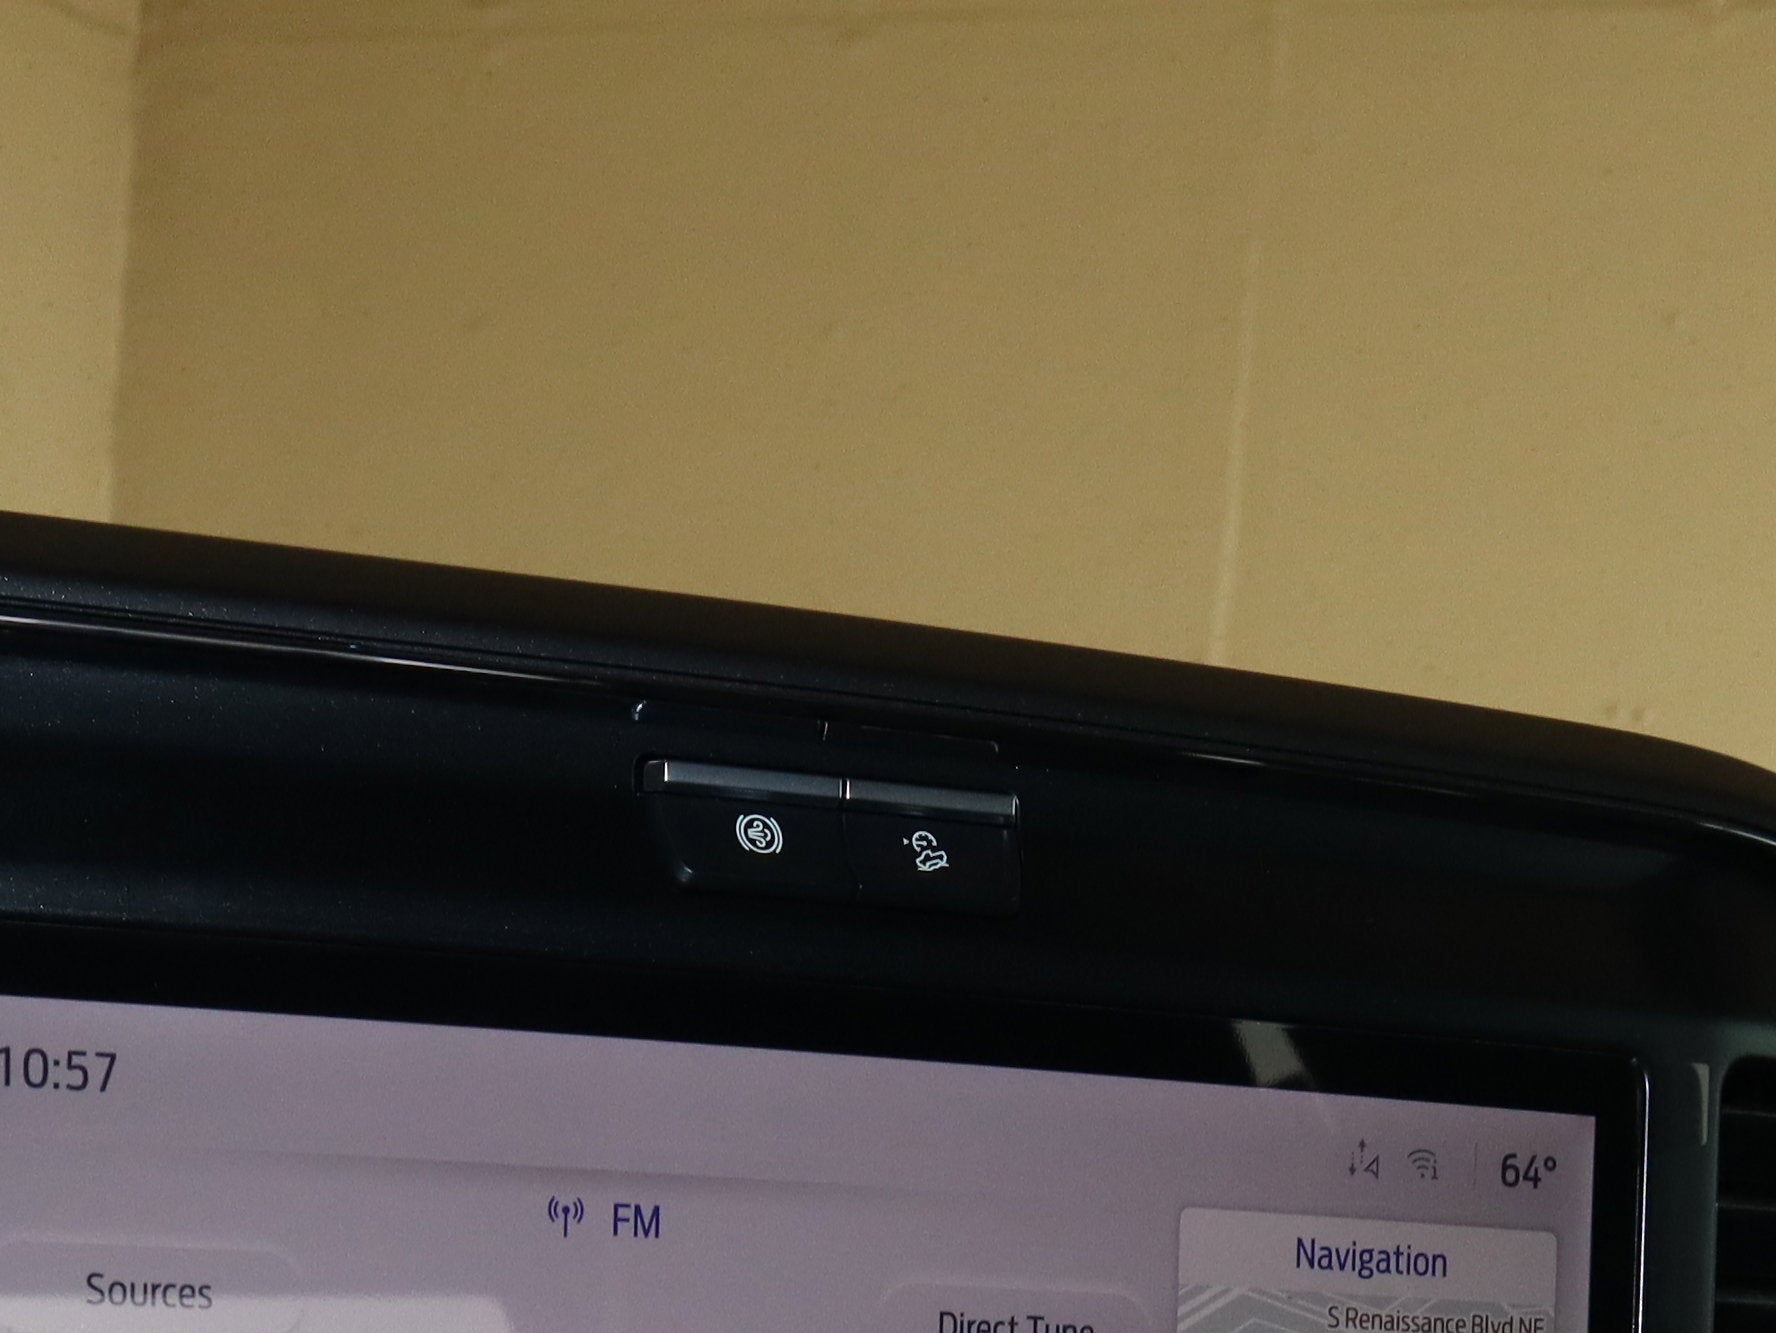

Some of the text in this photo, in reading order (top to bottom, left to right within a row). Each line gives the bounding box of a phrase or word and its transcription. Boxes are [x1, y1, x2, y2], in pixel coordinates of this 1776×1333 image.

[1499, 1153, 1557, 1190] 64°
[611, 1203, 661, 1239] FM
[1295, 1236, 1449, 1279] Navigation
[85, 1272, 214, 1310] Sources
[1327, 1306, 1341, 1329] S
